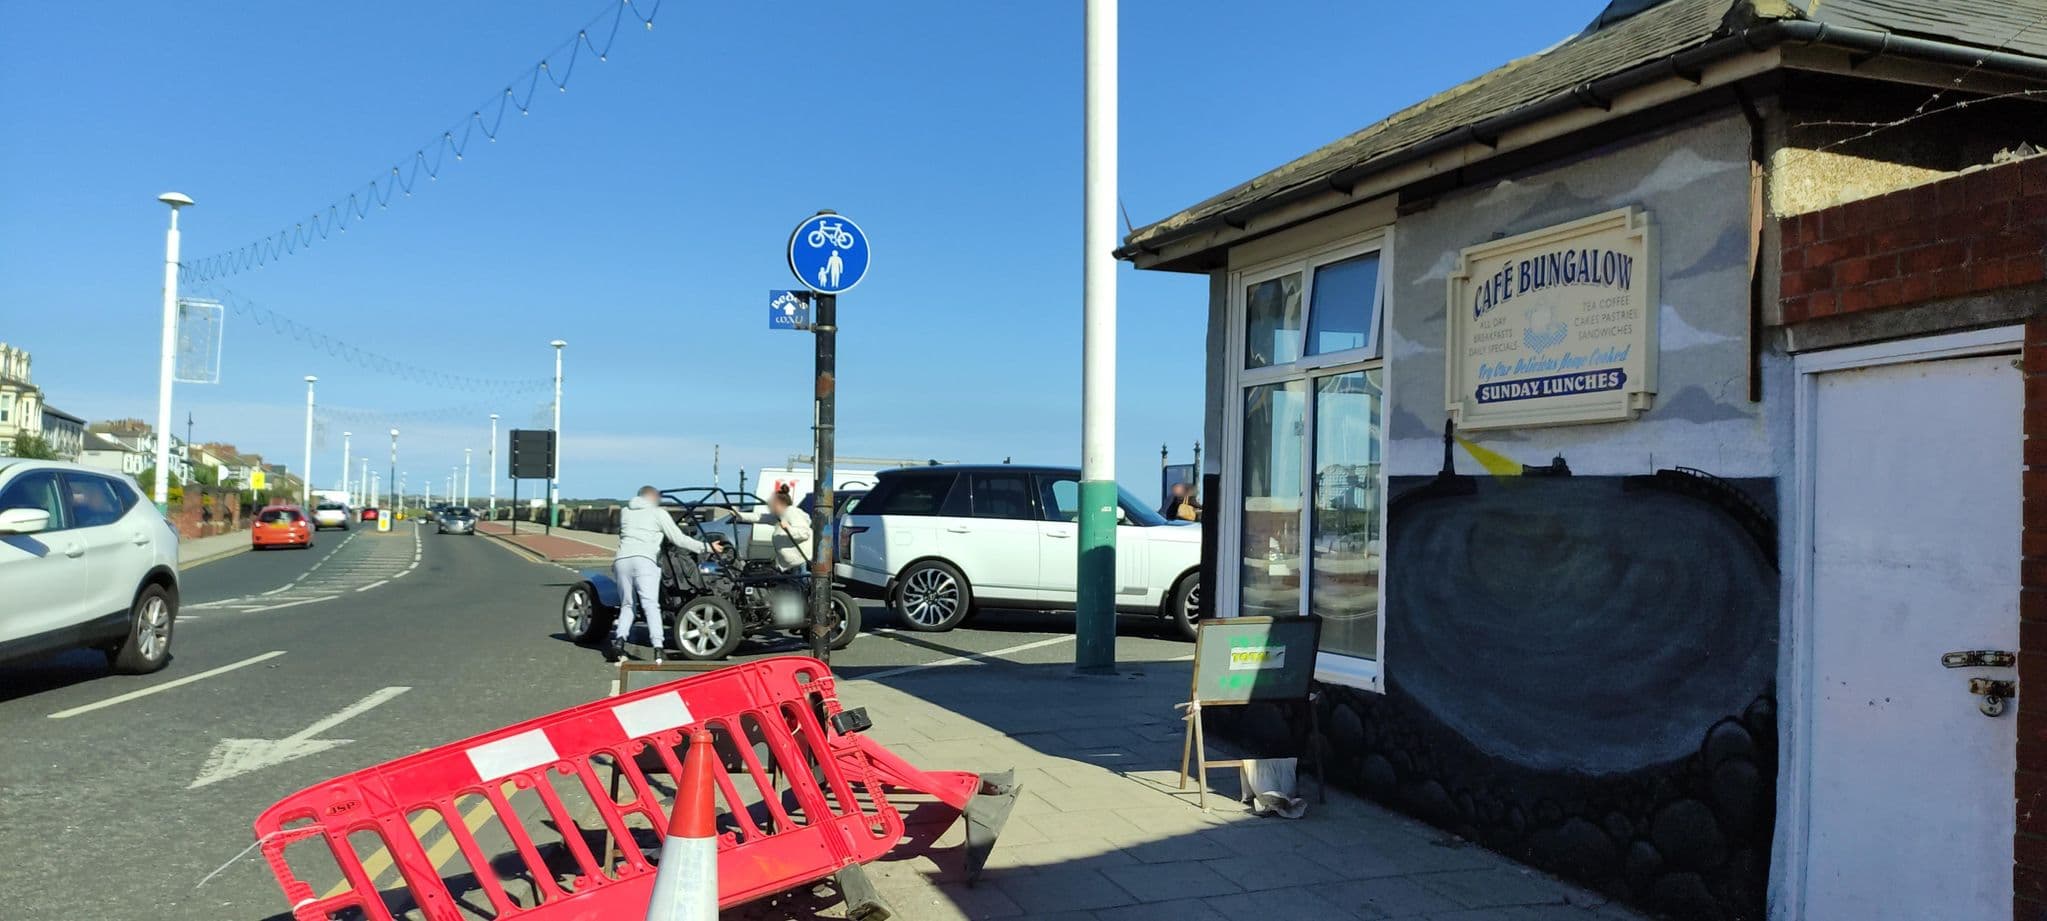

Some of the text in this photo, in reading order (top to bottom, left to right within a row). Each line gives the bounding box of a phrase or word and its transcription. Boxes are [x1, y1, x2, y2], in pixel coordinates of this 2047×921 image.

[1474, 249, 1633, 319] CAFÉ BUNGALOW
[1583, 295, 1630, 311] TEA COFFEE
[1479, 317, 1507, 329] ALL DAY
[1574, 308, 1640, 328] CAKES PASTRIES
[1577, 323, 1633, 341] SANDWICHES
[1469, 341, 1518, 357] DAILY SPECIALS
[1478, 343, 1632, 382] Try Our Delicious Home Cooked
[1481, 372, 1620, 401] SUNDAY LUNCHES
